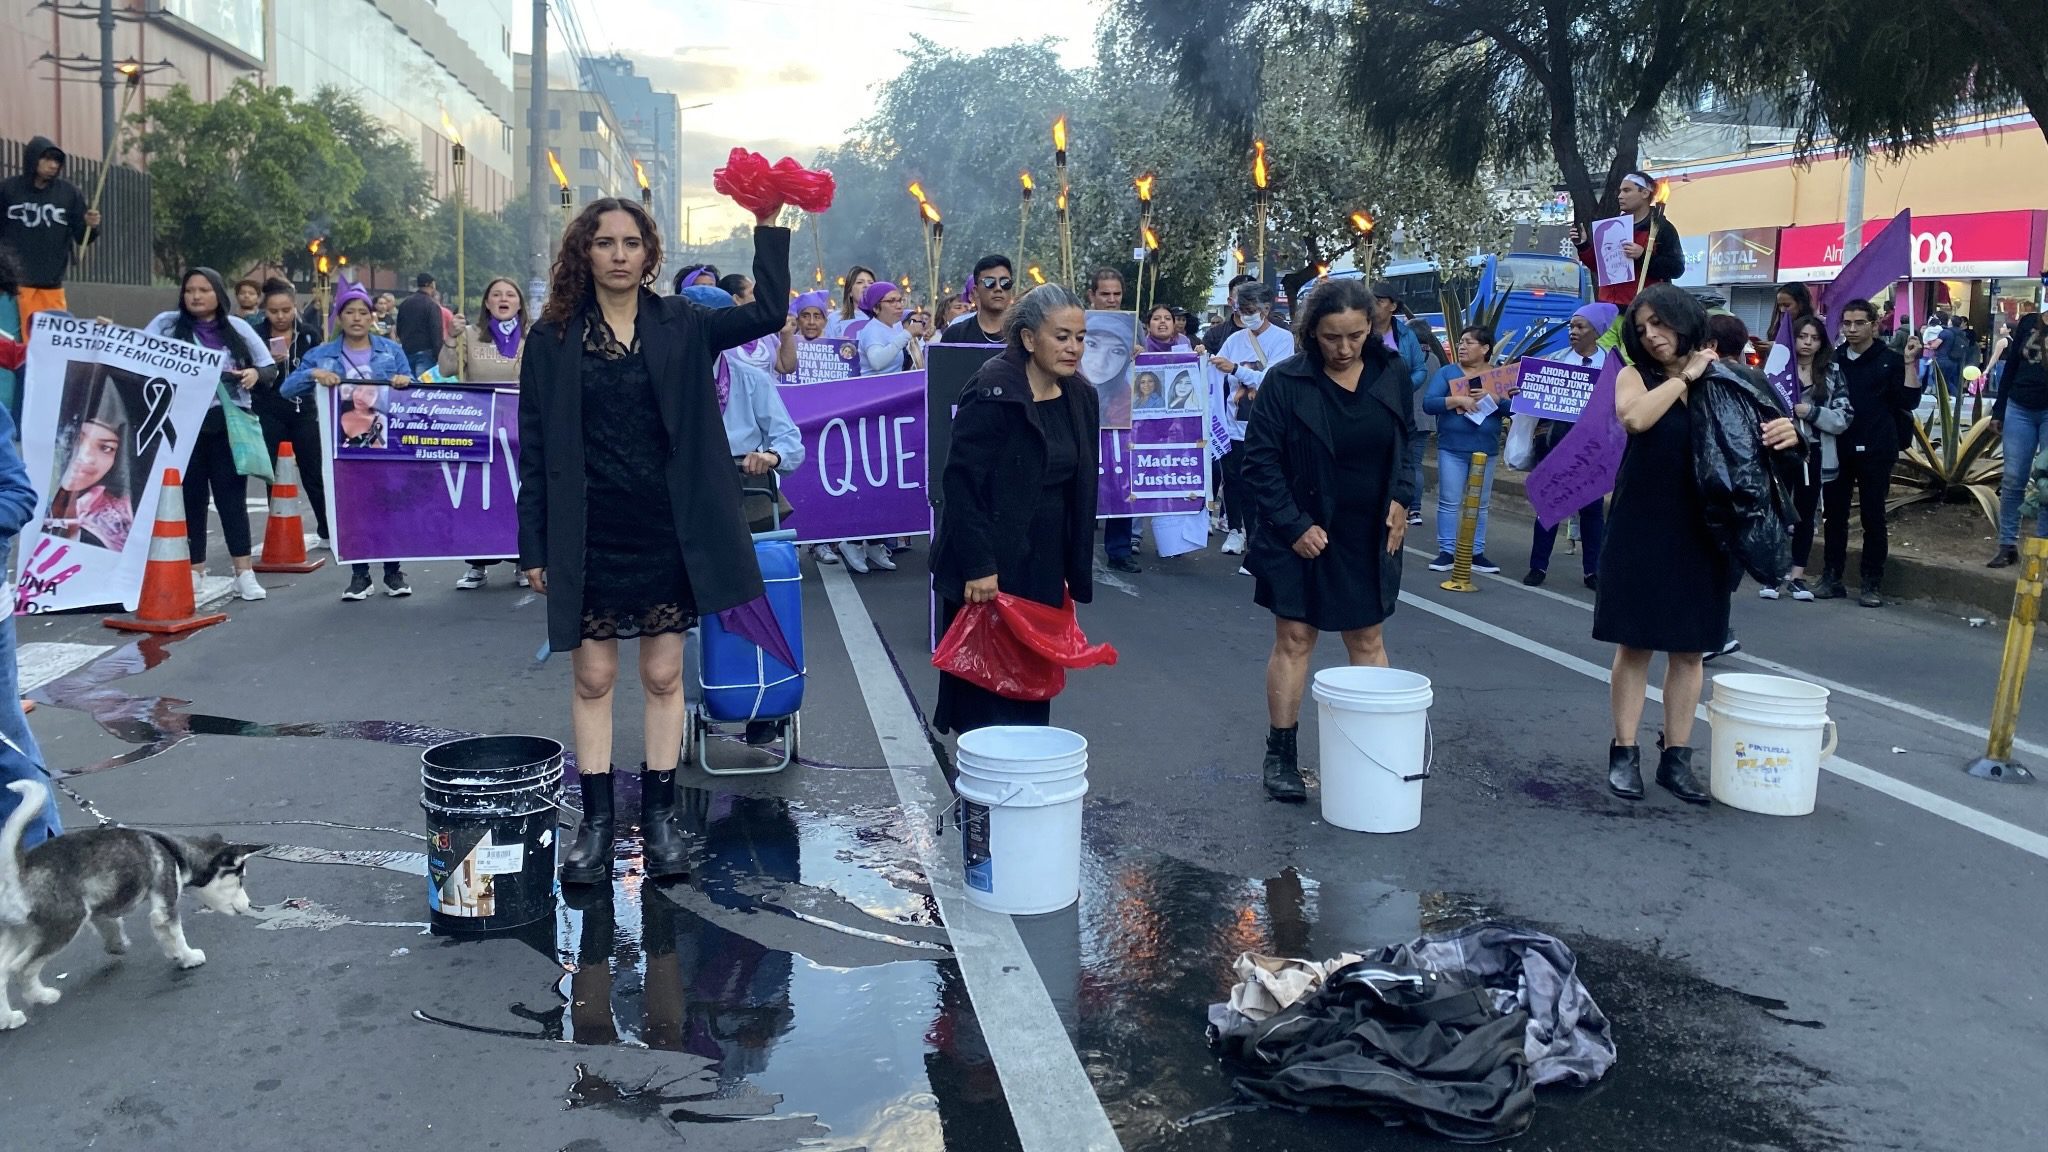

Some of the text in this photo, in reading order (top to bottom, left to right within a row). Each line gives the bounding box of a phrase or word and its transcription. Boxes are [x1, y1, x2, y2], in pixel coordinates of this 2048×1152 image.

[1710, 249, 1758, 265] HOSTAL
[36, 317, 221, 368] #NOS FALTA JOSSELYN
[797, 342, 835, 353] SANGRE
[115, 344, 201, 377] FEMICIDIOS
[798, 360, 853, 372] UNA MUJER.
[785, 373, 798, 383] DE
[798, 368, 849, 379] LA SANGRE
[1524, 372, 1566, 386] ESTAMOS
[1540, 366, 1590, 382] AHORA QUE
[411, 388, 463, 401] de género
[1521, 381, 1550, 393] AHORA
[1551, 386, 1570, 396] QUE
[1571, 389, 1582, 398] YA
[1544, 394, 1557, 403] NO
[1559, 396, 1578, 406] NOS
[389, 402, 484, 417] No más femicidios
[1534, 401, 1582, 415] A CALLAR!!
[389, 418, 487, 432] No más impunidad
[401, 435, 474, 446] #Ni una menos
[415, 449, 460, 459] #Justicia
[818, 415, 920, 497] QUE
[1137, 453, 1199, 468] Madres
[1132, 471, 1203, 487] Justicia
